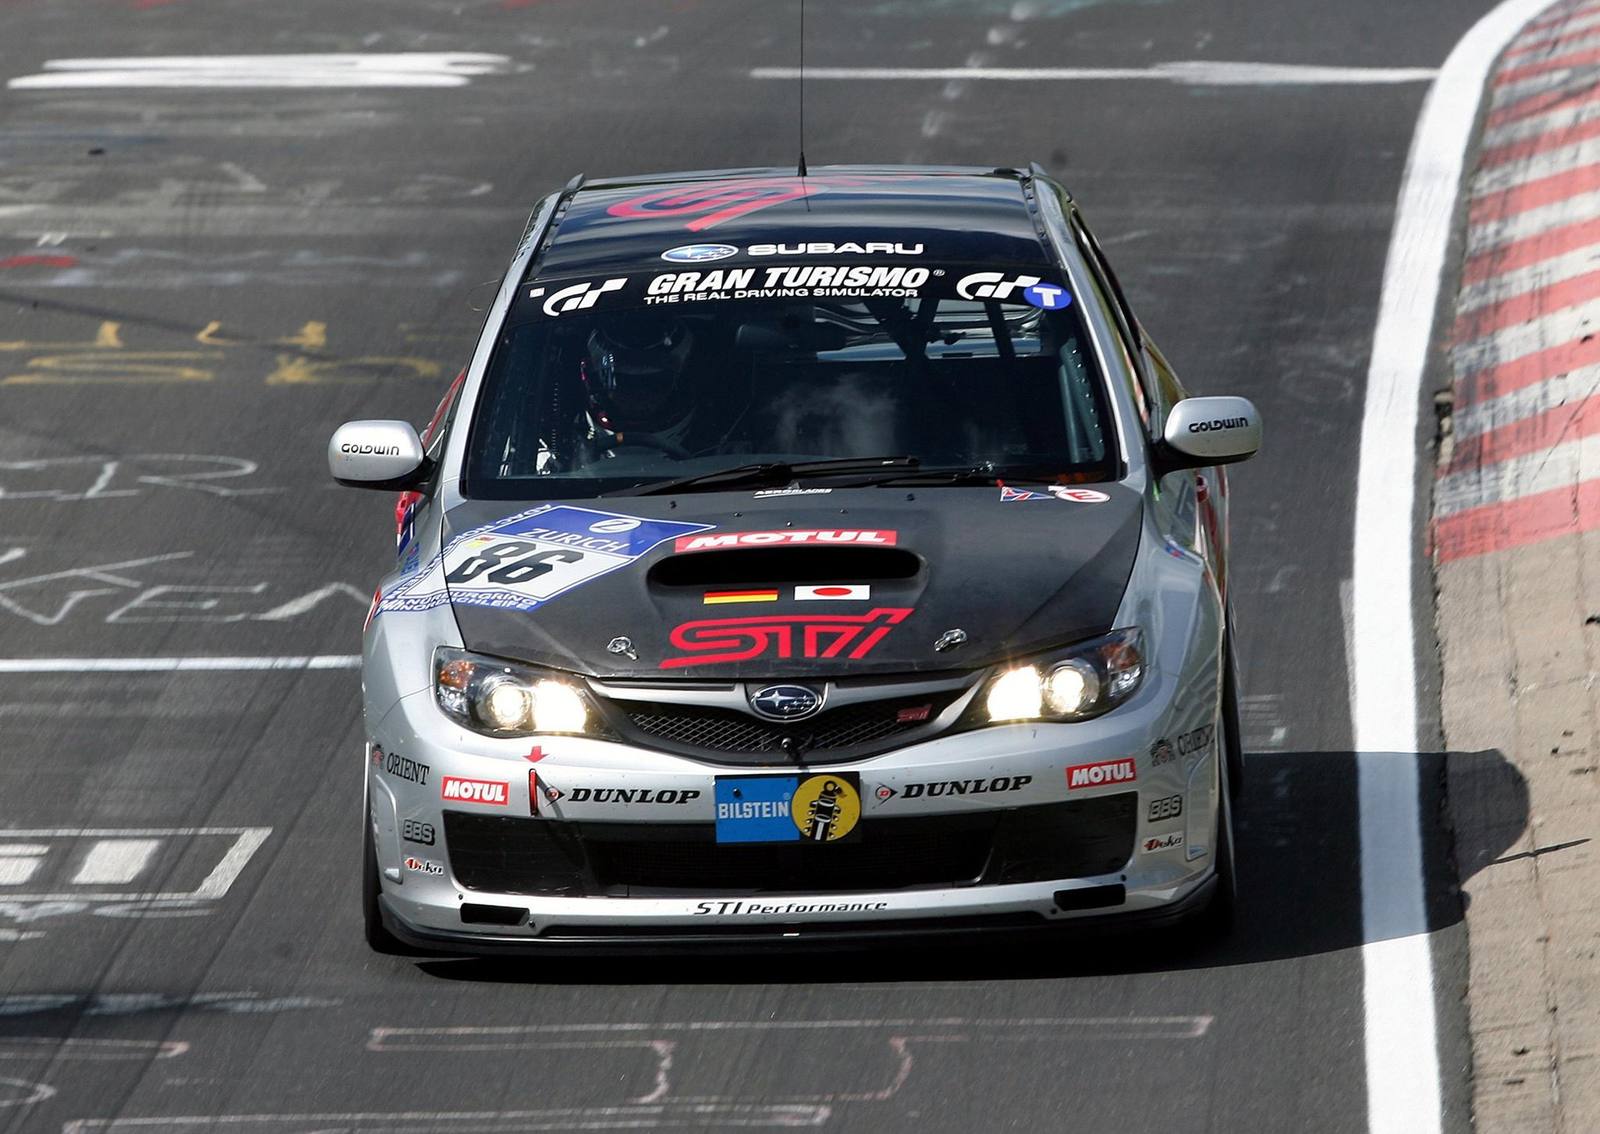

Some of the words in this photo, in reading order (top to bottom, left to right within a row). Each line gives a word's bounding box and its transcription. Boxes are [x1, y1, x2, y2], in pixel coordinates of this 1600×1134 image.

[748, 242, 923, 256] SUBARU
[647, 268, 756, 295] GRAN
[764, 266, 930, 289] TURISMO
[643, 295, 679, 305] THE
[684, 291, 731, 302] REAL
[734, 288, 809, 299] DRIVING
[813, 287, 918, 298] SIMULATOR
[1032, 287, 1062, 307] T
[1188, 417, 1249, 433] GOLDWIN
[341, 443, 400, 456] GOLDWIN
[518, 527, 632, 553] ZURICH
[684, 531, 887, 549] MOTUL
[446, 541, 584, 585] 86
[387, 752, 430, 786] ORIENT
[1071, 762, 1134, 786] MOTUL
[444, 778, 506, 802] MOTUL
[568, 787, 700, 804] DUNLOP
[901, 775, 1033, 799] DUNLOP
[718, 801, 790, 819] BILSTEIN
[1148, 795, 1182, 822] BBS
[402, 819, 435, 846] BBS
[694, 901, 743, 915] STI
[747, 901, 888, 914] Performance
